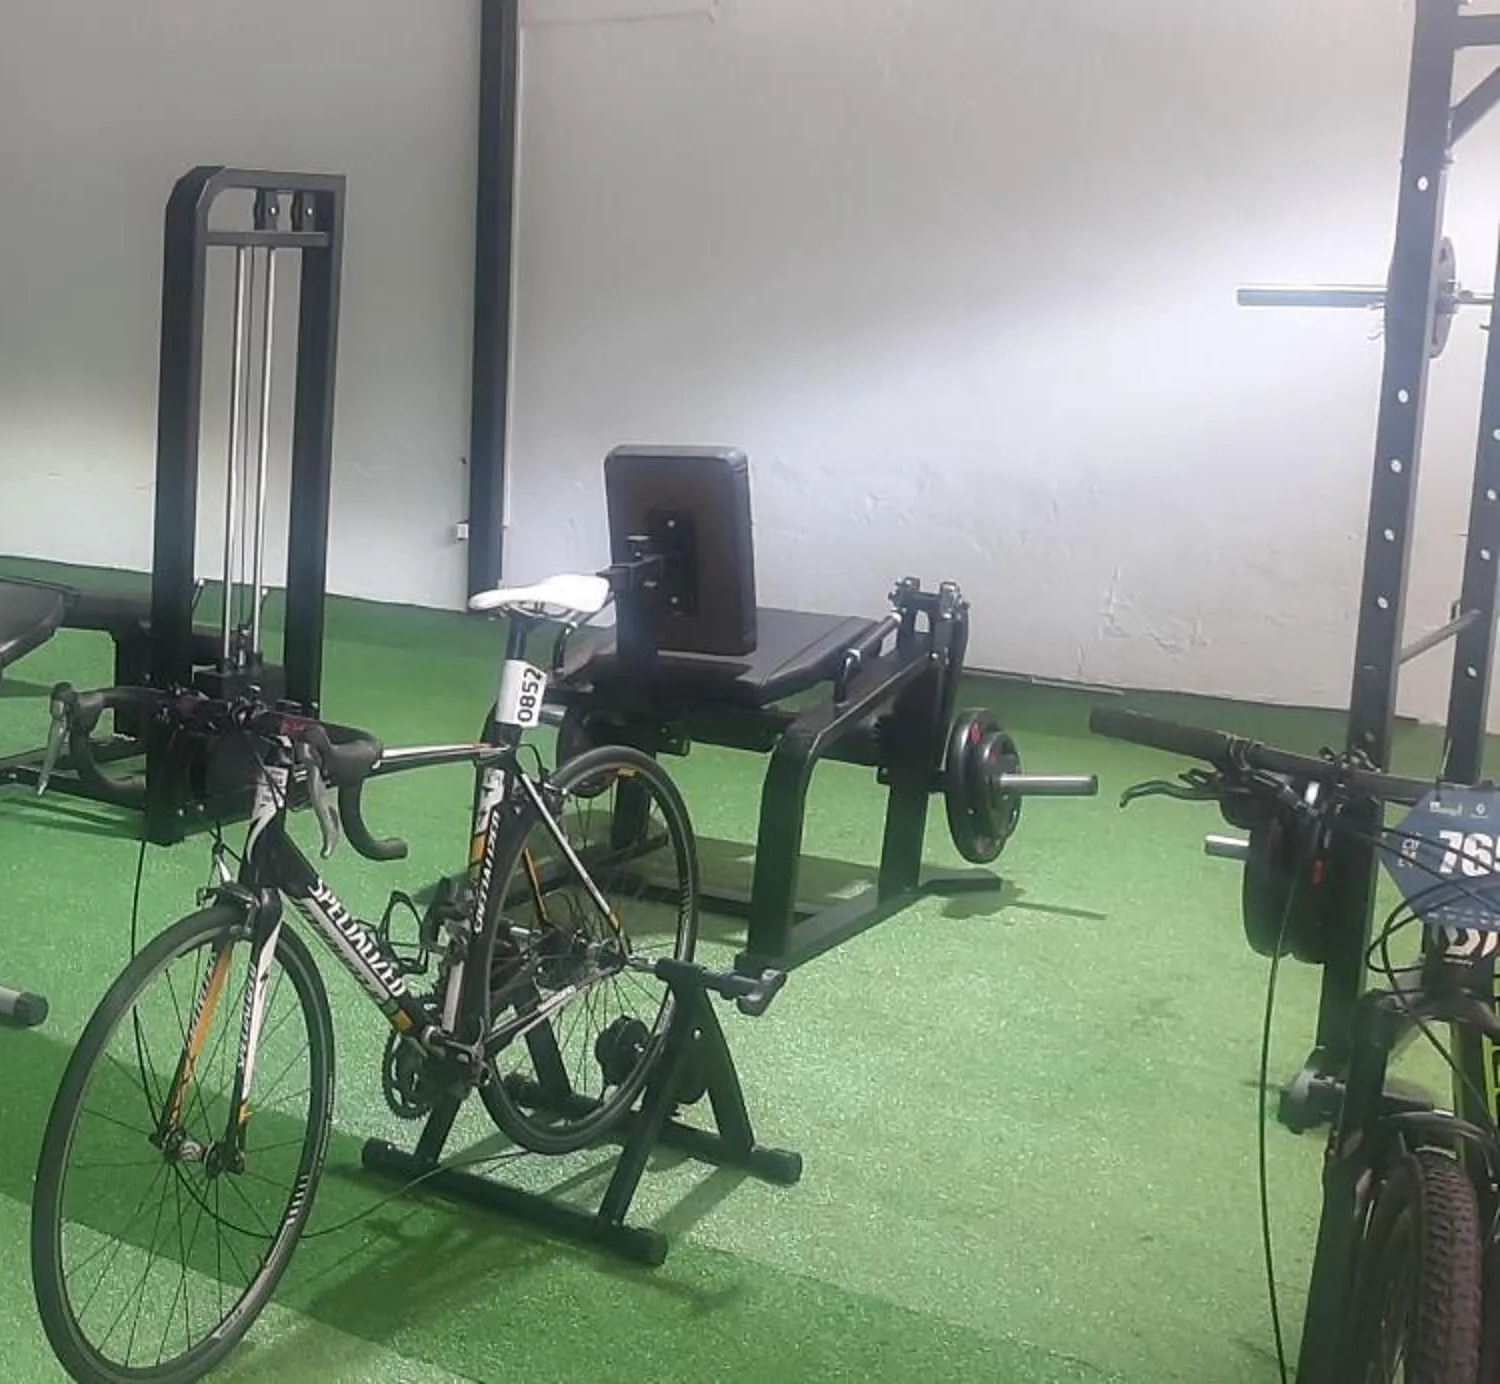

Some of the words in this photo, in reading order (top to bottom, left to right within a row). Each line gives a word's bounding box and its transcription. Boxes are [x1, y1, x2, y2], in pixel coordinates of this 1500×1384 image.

[517, 667, 542, 723] 0852
[1439, 829, 1500, 877] 76
[307, 875, 407, 997] SPECIALIZED
